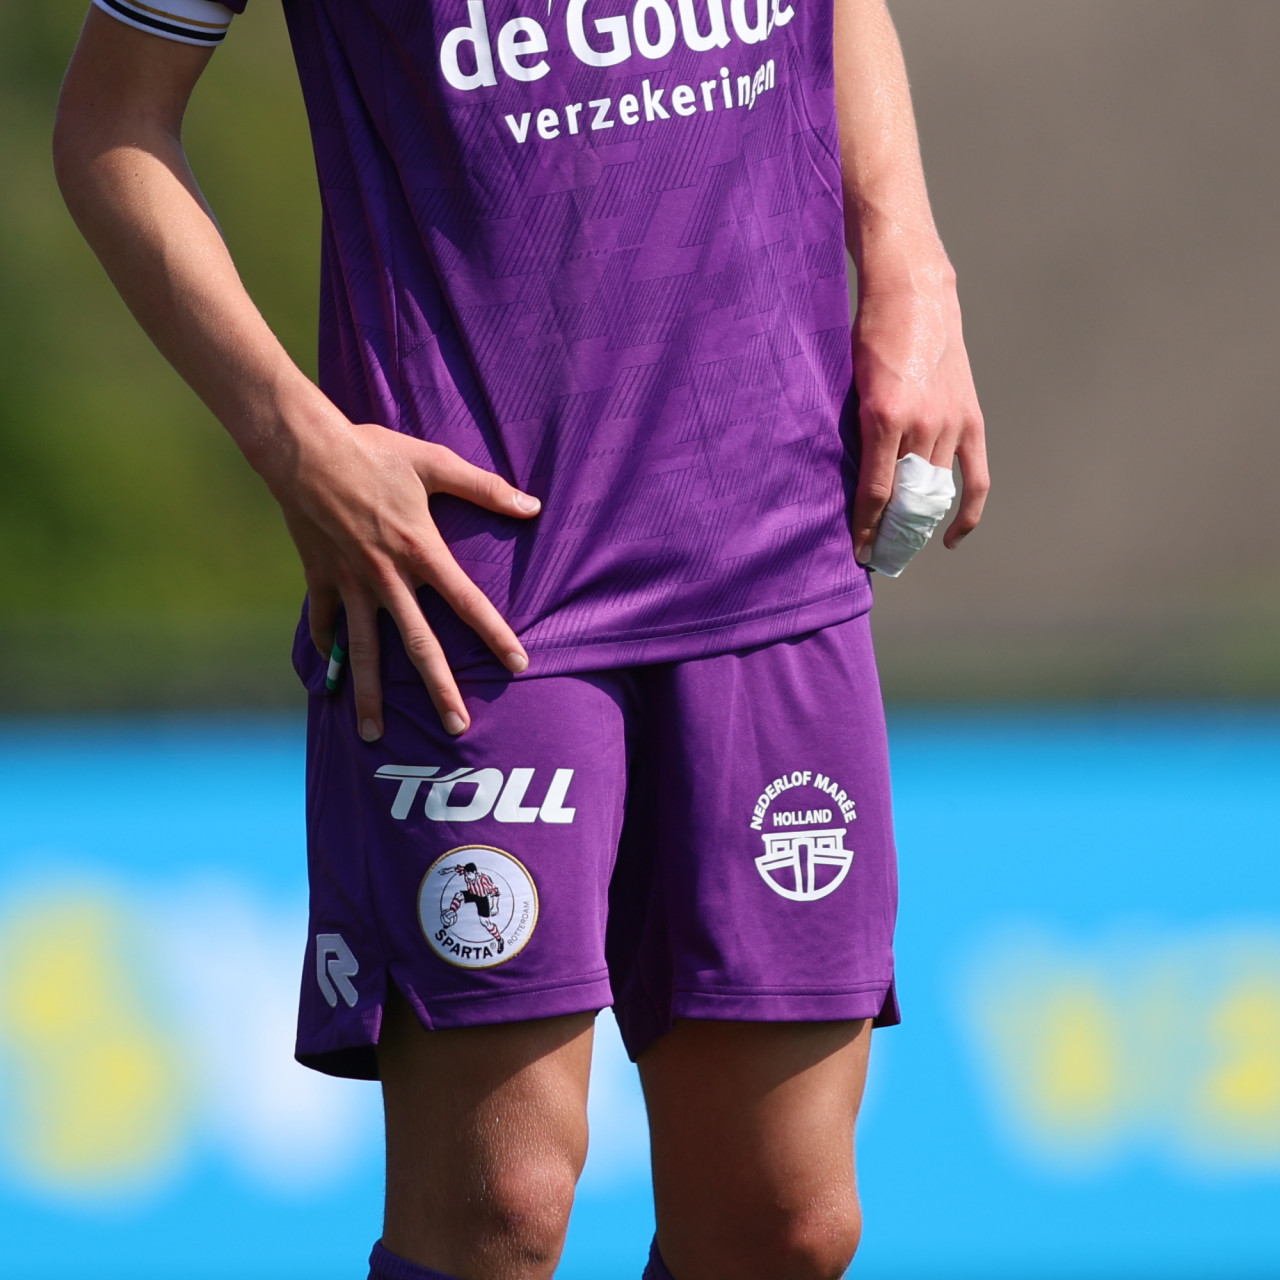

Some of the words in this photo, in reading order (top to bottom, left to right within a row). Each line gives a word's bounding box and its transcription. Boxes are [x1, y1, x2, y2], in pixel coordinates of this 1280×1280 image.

[439, 0, 551, 91] de
[373, 764, 577, 824] TOLL
[750, 770, 812, 831] NEDERLOF
[813, 773, 857, 824] MARÉE
[772, 809, 833, 827] HOLLAND
[435, 928, 493, 960] SPARTA
[506, 900, 531, 946] ROTTERDAM
